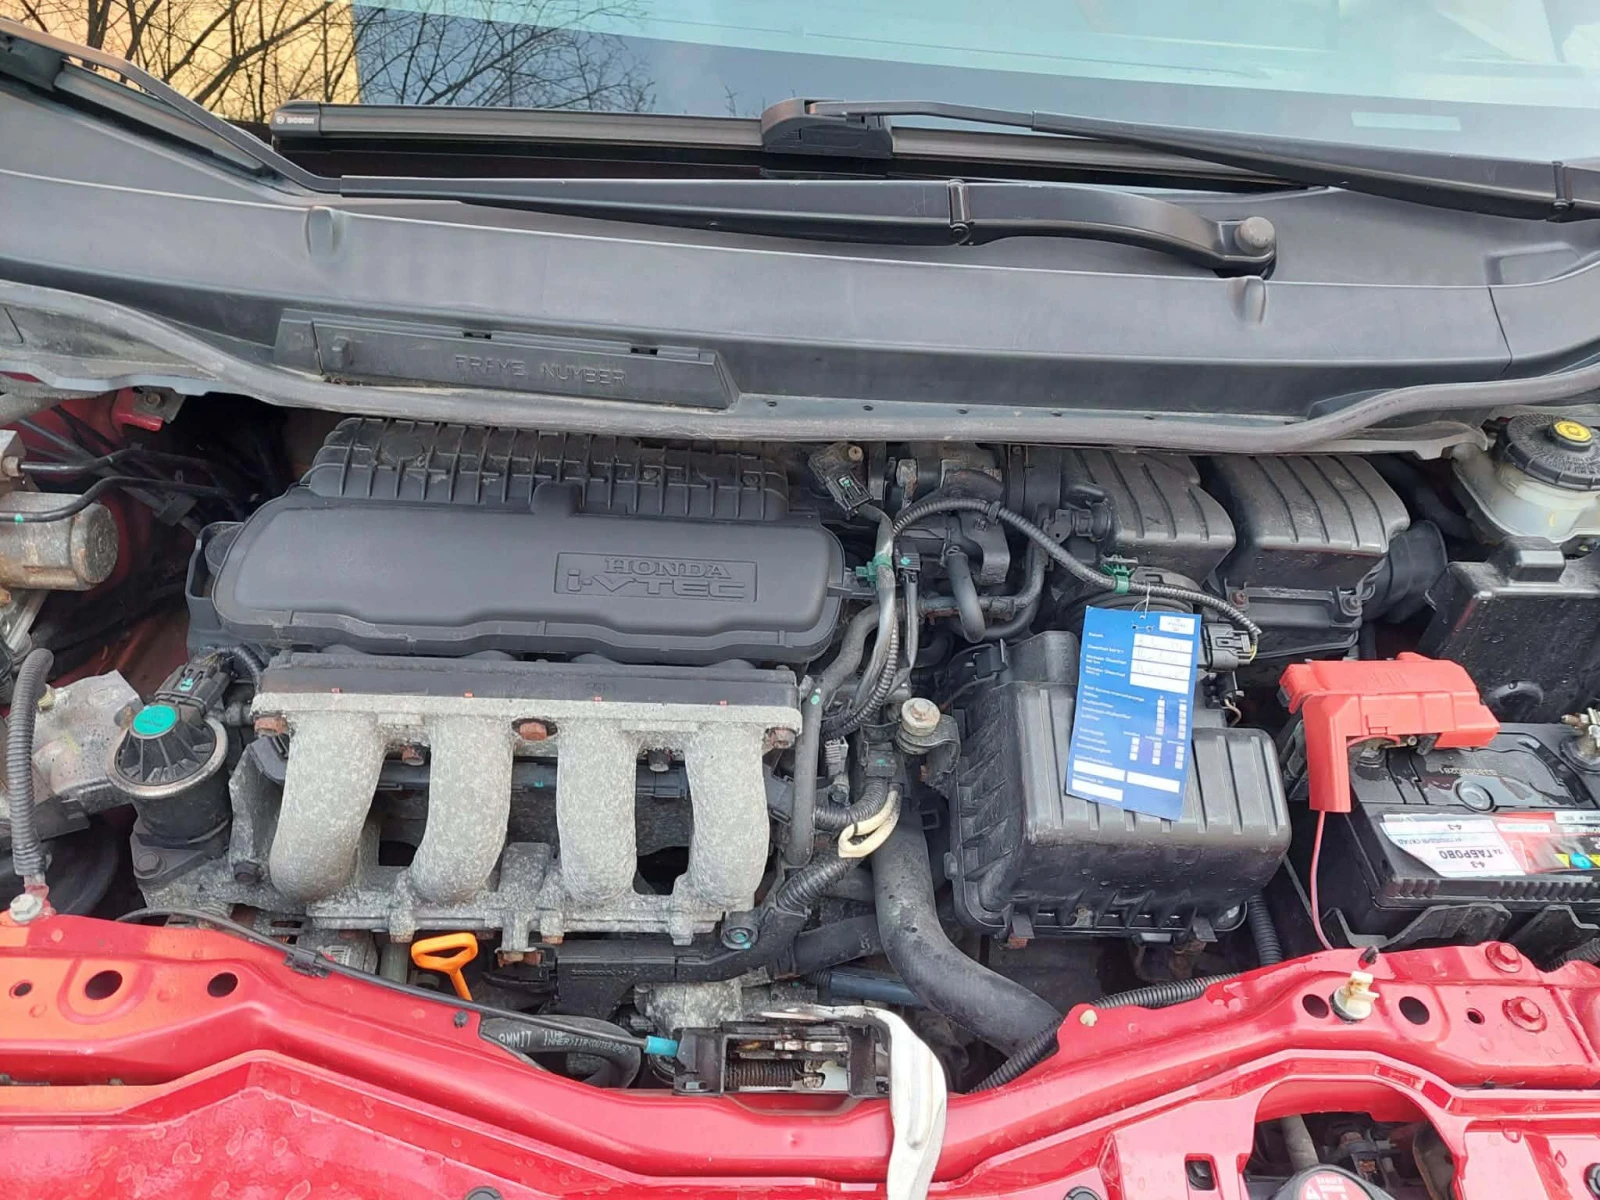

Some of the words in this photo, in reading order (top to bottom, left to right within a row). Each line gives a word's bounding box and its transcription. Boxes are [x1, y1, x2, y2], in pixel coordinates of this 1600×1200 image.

[455, 354, 525, 377] FRAME
[541, 362, 626, 386] NUMBER
[604, 557, 732, 579] HONDA
[1438, 849, 1493, 860] ГАБРОВО
